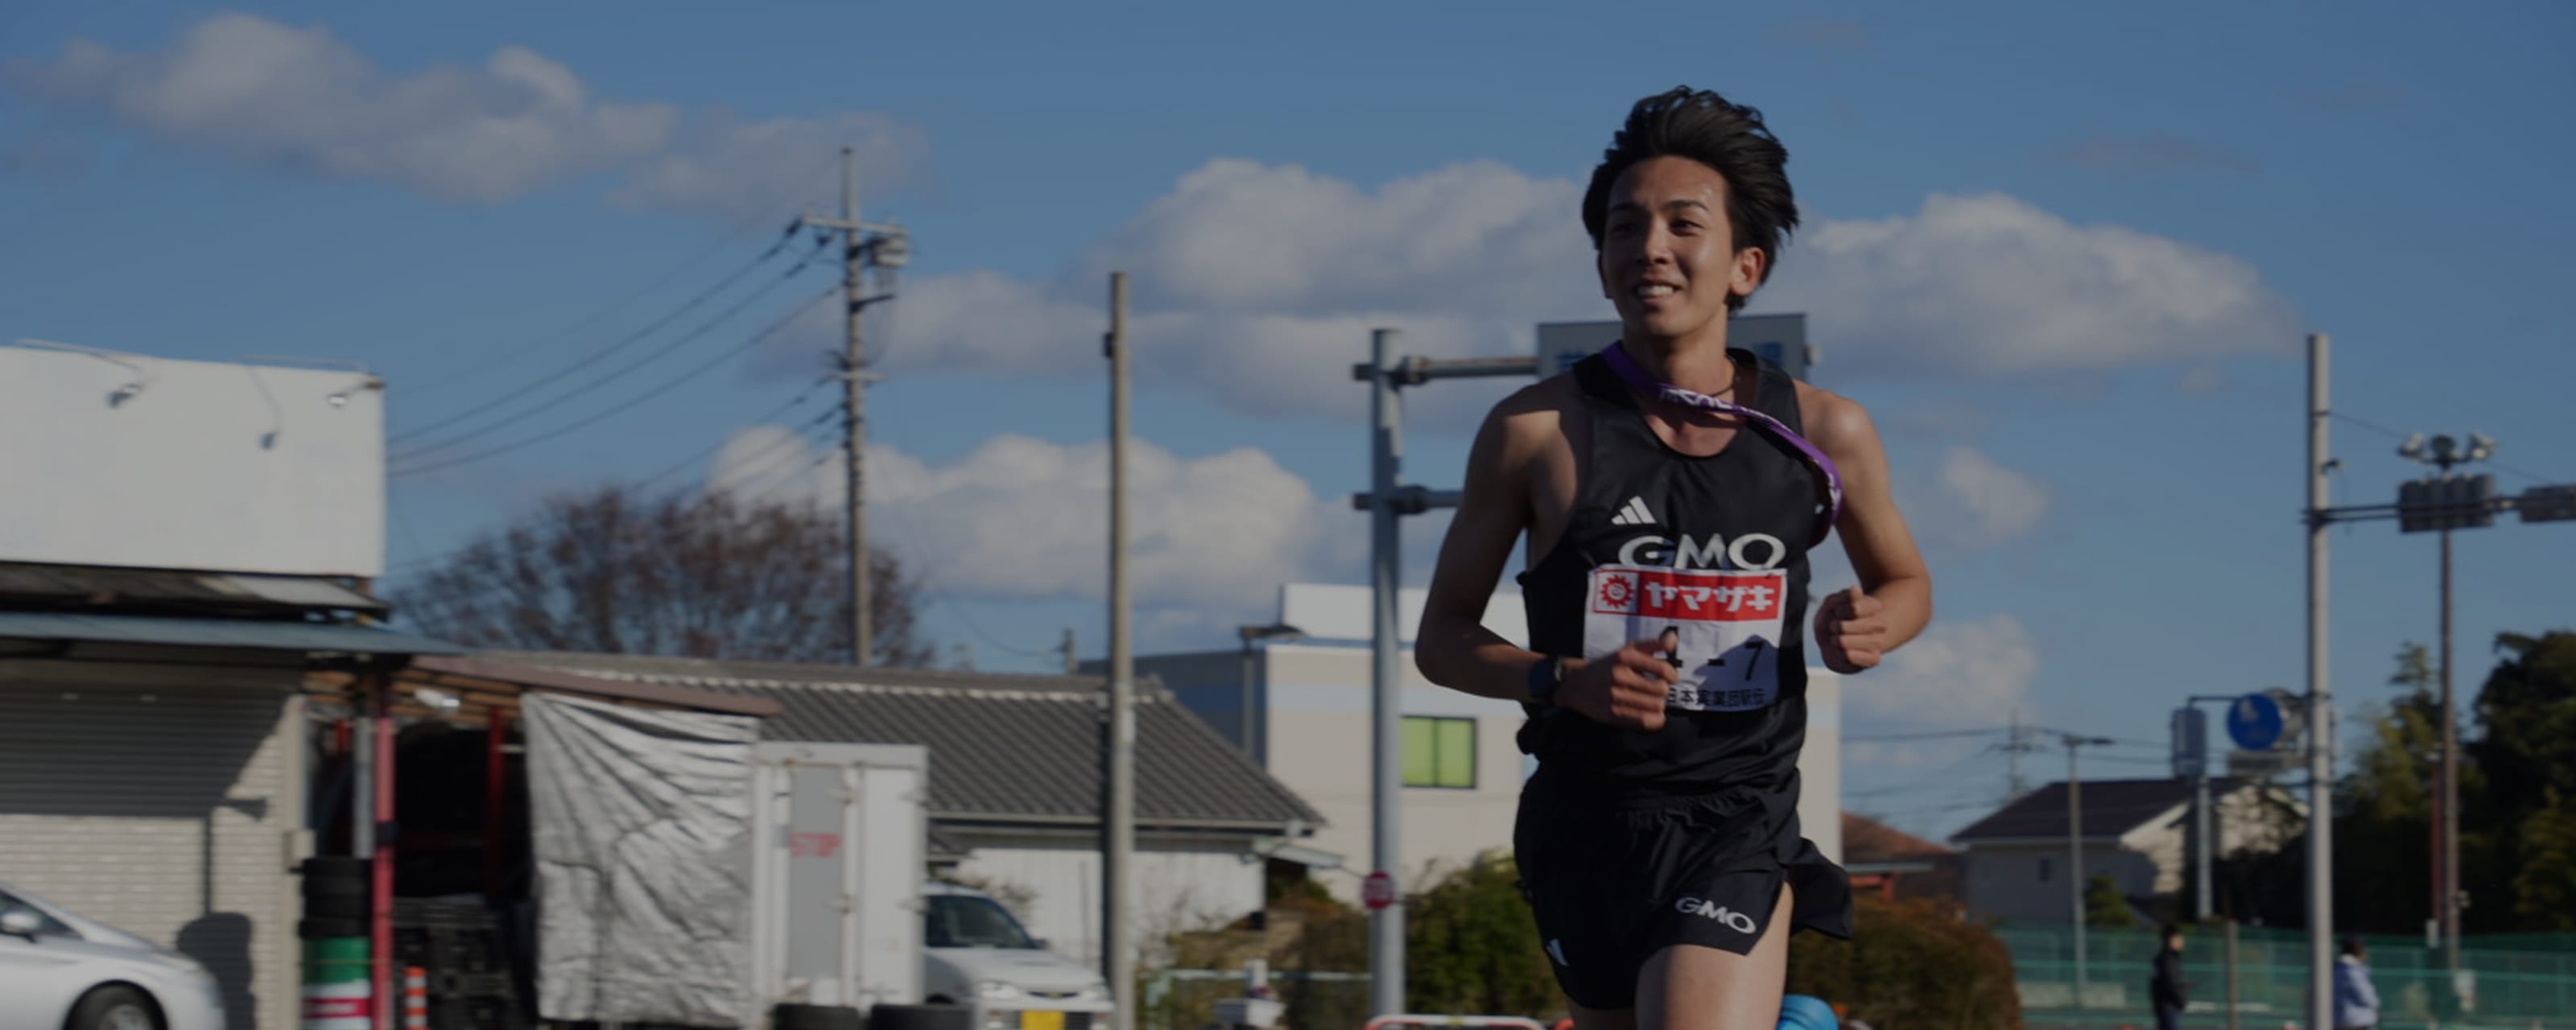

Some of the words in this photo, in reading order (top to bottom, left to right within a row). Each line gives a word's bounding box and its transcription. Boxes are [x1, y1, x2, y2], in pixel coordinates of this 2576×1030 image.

[1618, 533, 1787, 571] GMO
[1644, 580, 1775, 612] ヤマザキ
[1675, 896, 1757, 934] GMO
